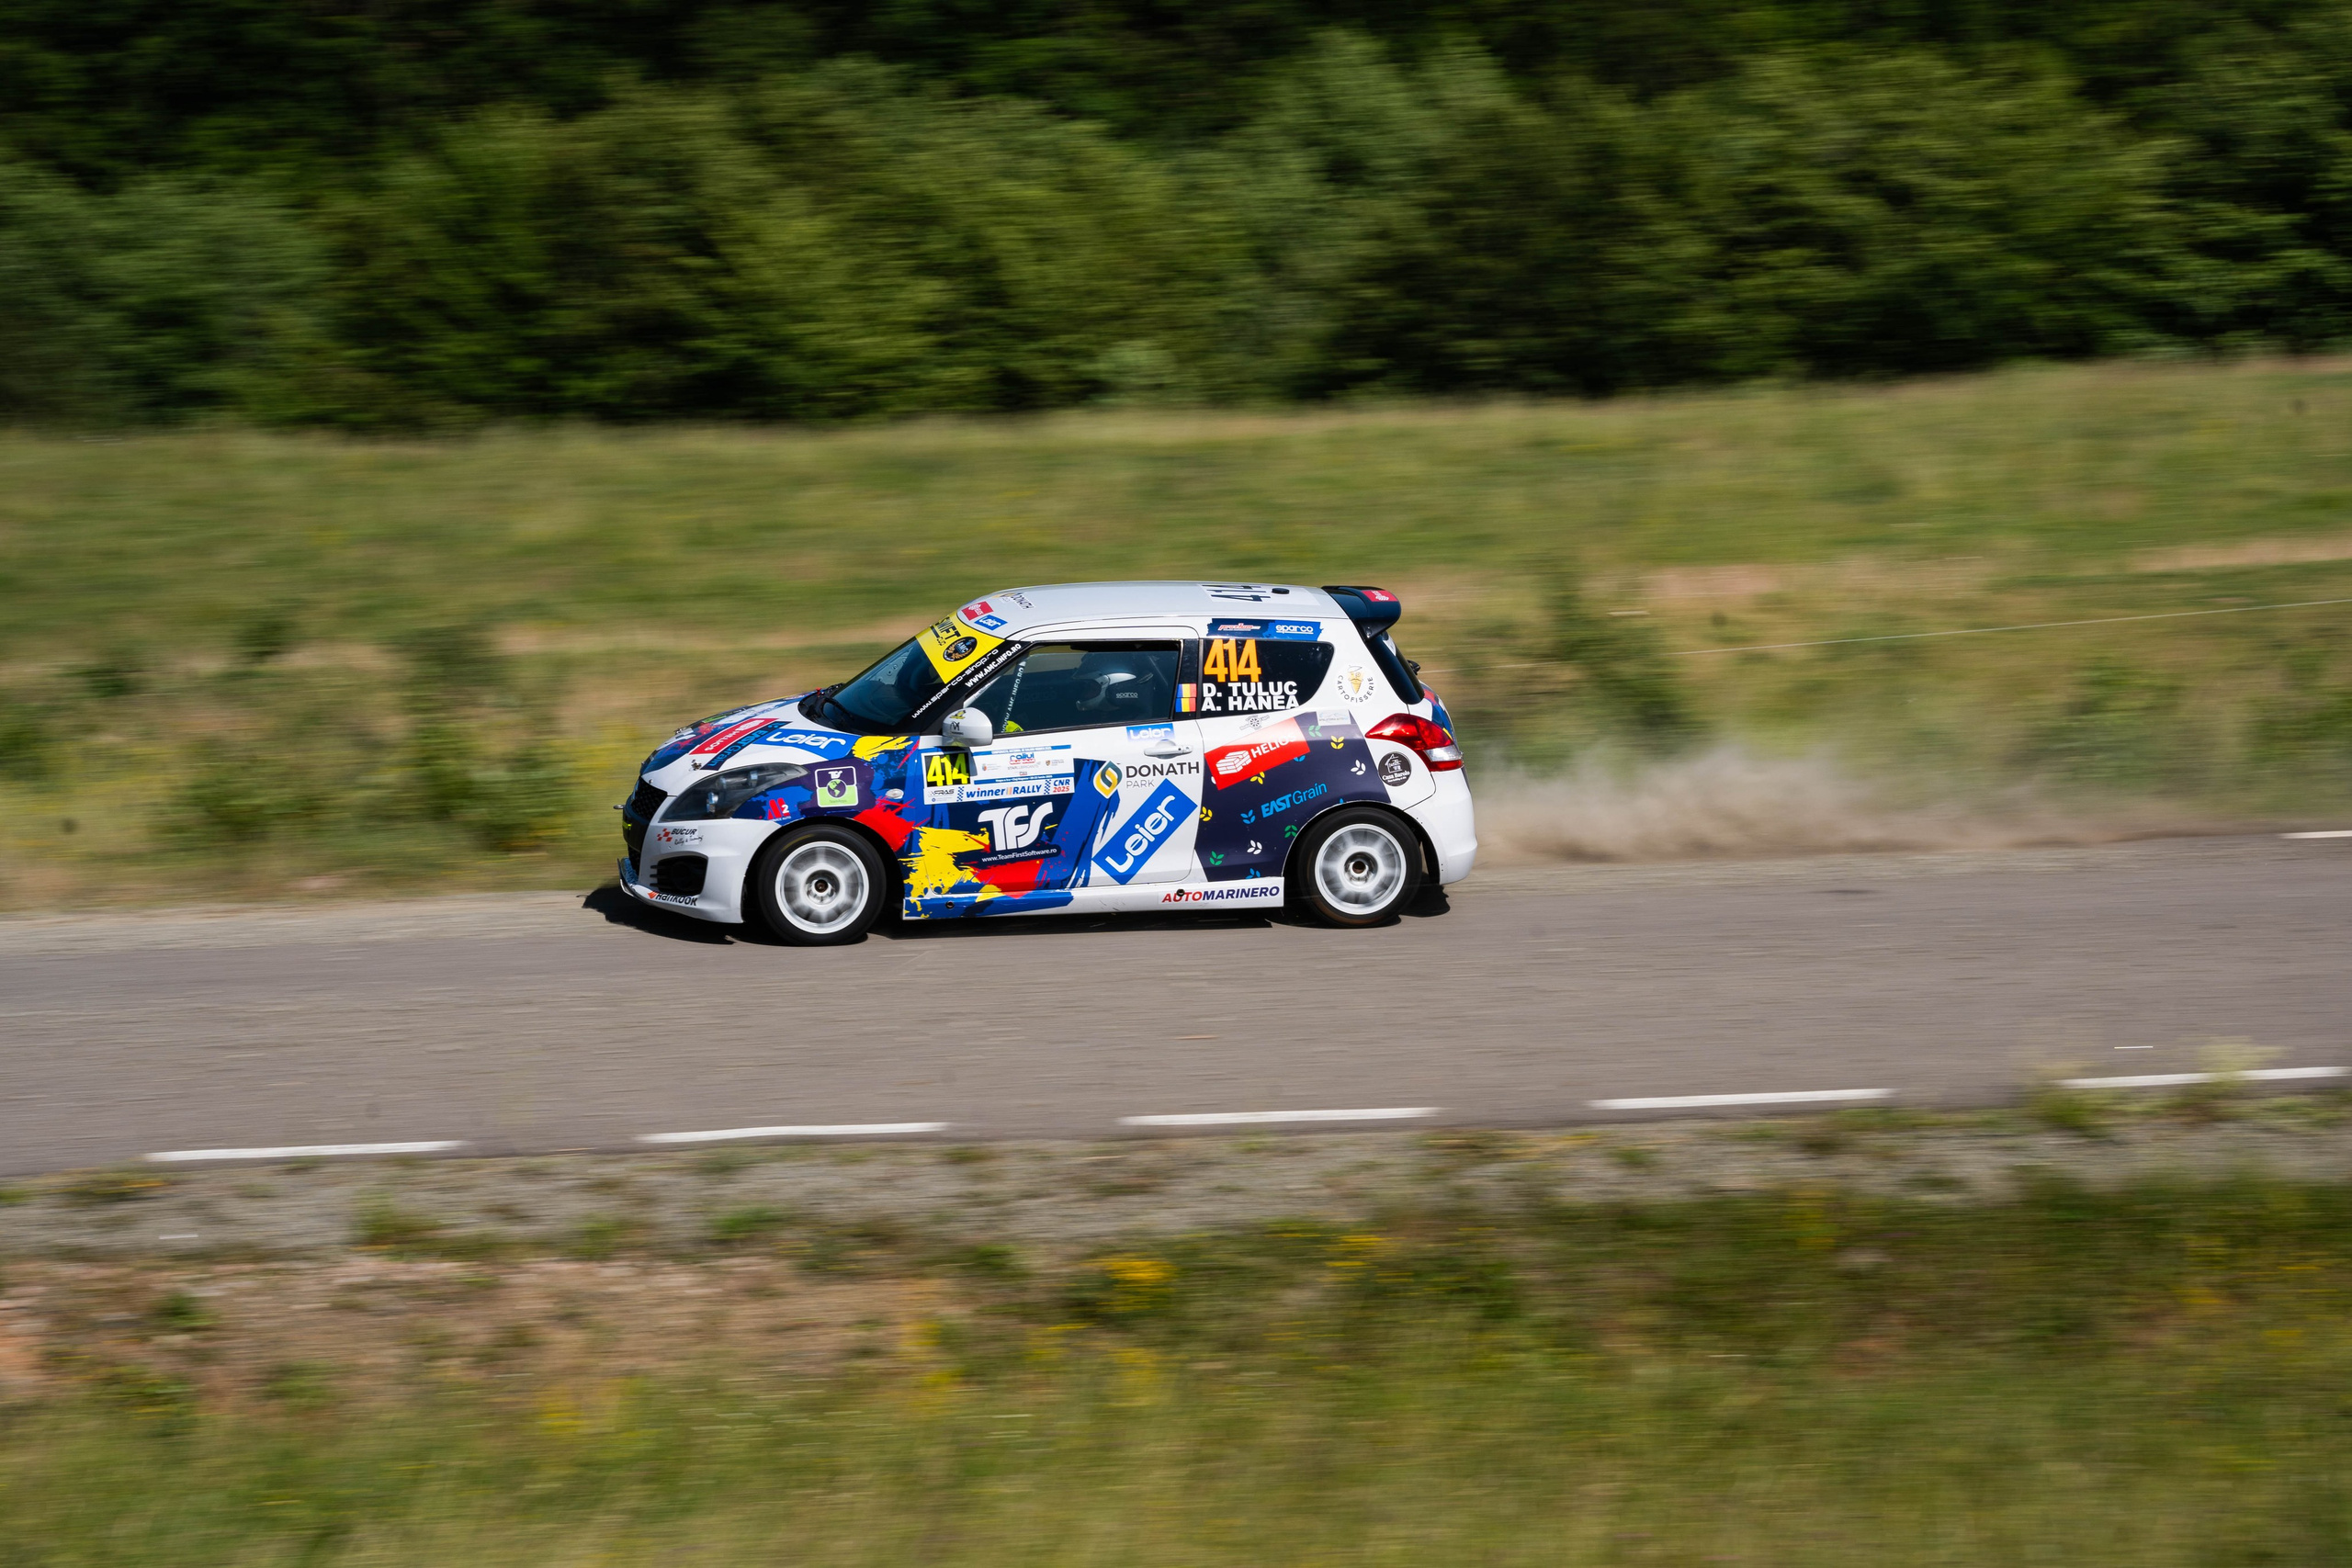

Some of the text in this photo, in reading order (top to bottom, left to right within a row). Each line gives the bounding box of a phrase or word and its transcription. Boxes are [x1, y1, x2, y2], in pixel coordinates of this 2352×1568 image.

[1275, 625, 1314, 634] sparco
[1204, 637, 1261, 682] 414
[912, 649, 999, 719] www.sparco-shop.ro
[1203, 681, 1297, 697] D. TULUC
[1337, 675, 1374, 703] CARTOFISSERIE
[1201, 694, 1299, 711] A. HANEA
[766, 731, 846, 750] Leier
[1250, 735, 1297, 759] HELIOS
[927, 753, 969, 786] 414
[1125, 761, 1200, 778] DONATH
[1012, 784, 1042, 795] RALLY
[1126, 779, 1155, 788] PARK
[1261, 783, 1328, 818] EASTGrain
[978, 801, 1053, 852] TFS
[1104, 795, 1176, 874] Leier
[981, 848, 1057, 863] www.TeamFirstSoftware.ro
[1161, 886, 1280, 903] AUTOMARINERO
